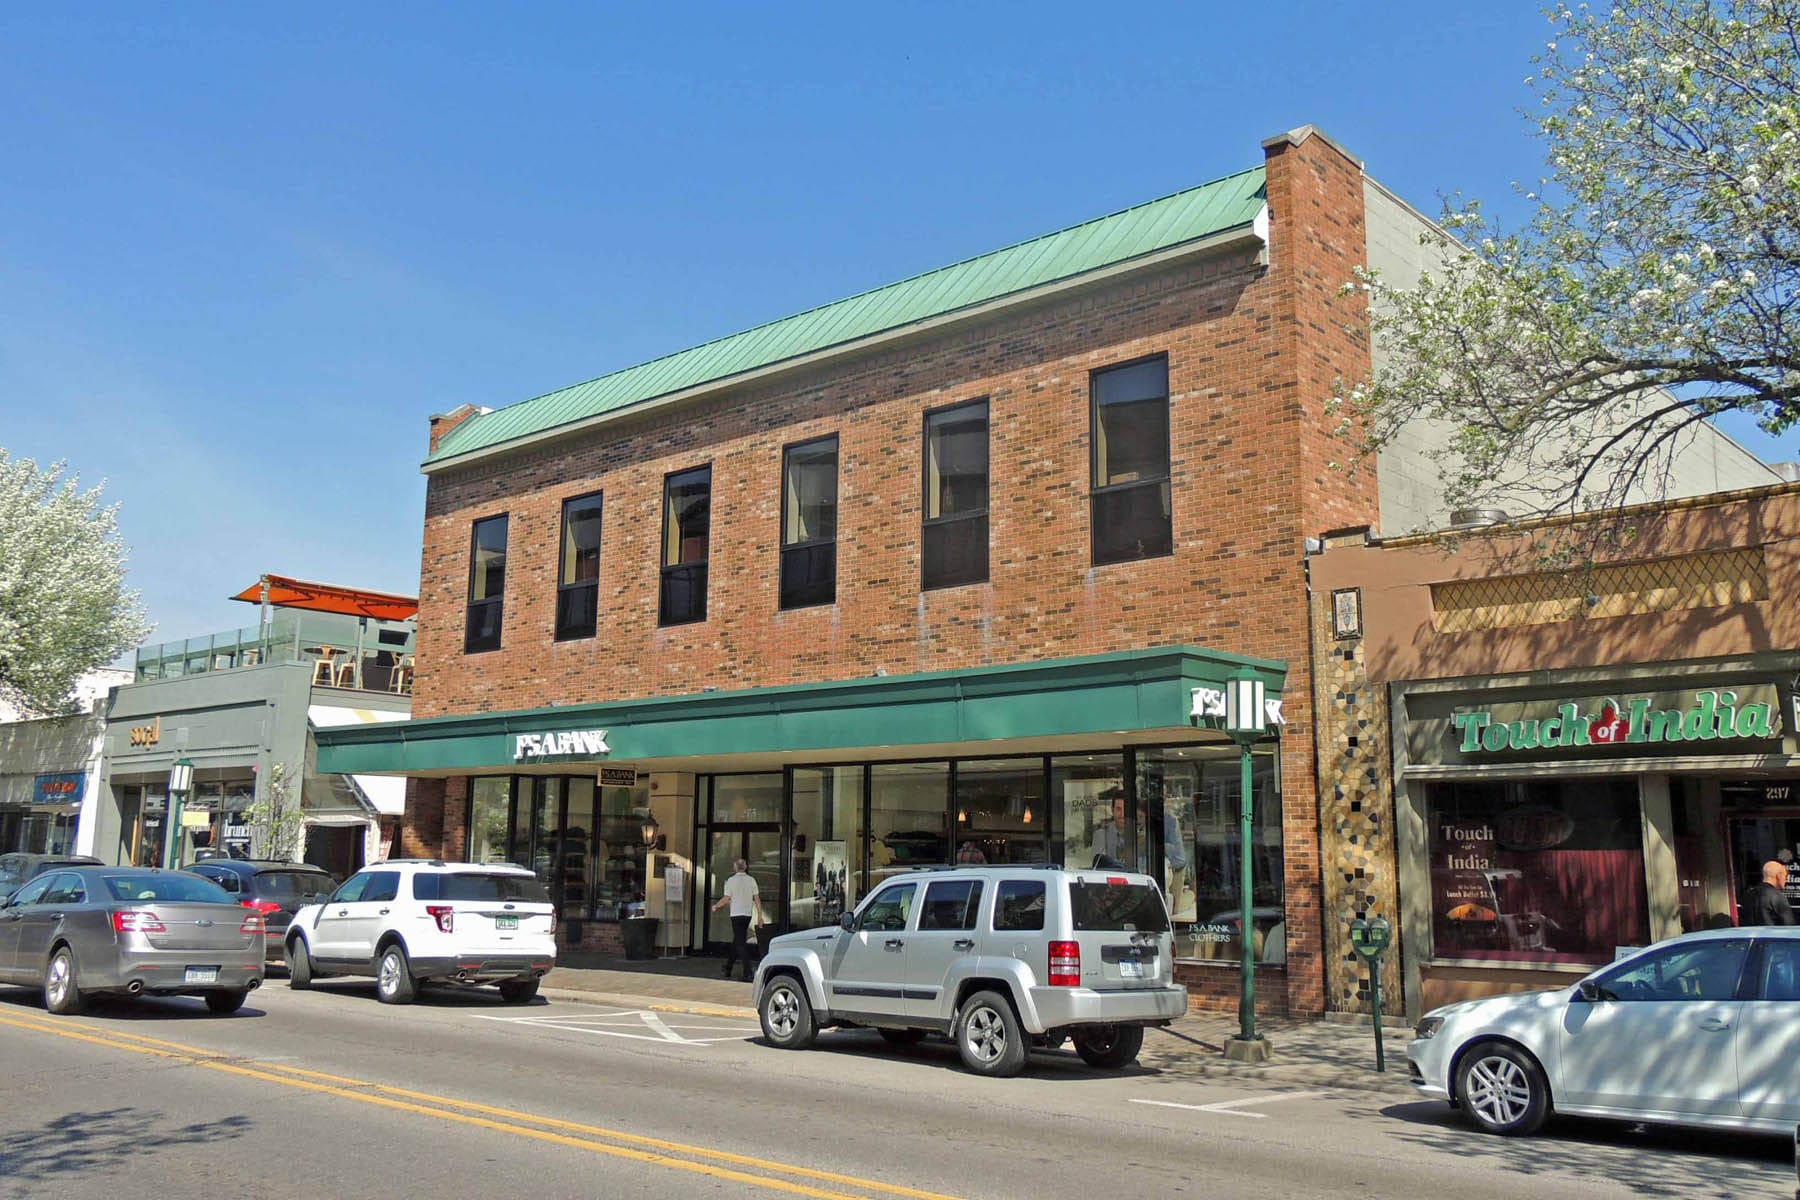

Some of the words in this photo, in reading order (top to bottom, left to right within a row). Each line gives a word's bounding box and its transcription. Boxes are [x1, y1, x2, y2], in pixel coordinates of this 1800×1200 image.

[1455, 702, 1592, 753] Touch
[1597, 719, 1620, 742] of
[1626, 690, 1772, 742] India
[1766, 787, 1789, 799] 297
[1441, 824, 1494, 841] Touch
[1448, 854, 1489, 870] India
